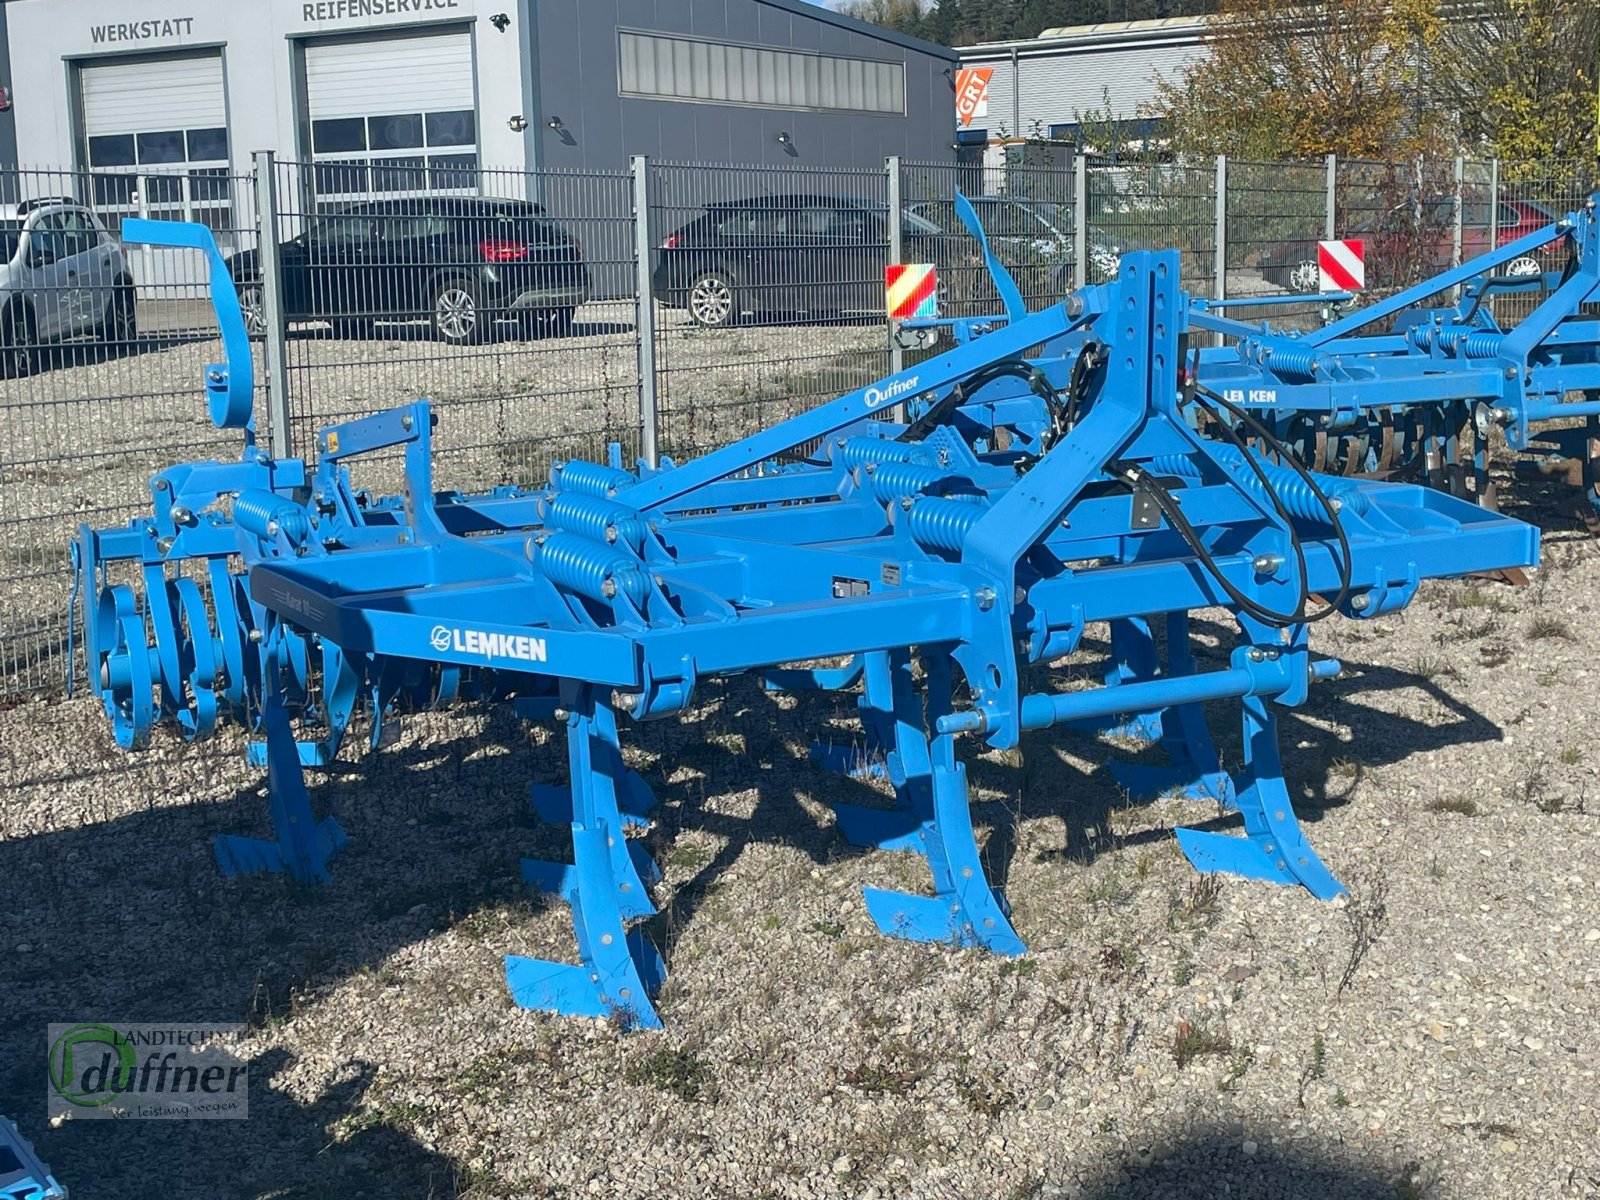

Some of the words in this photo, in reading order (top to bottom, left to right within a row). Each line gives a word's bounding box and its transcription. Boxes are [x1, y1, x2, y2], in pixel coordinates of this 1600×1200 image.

[91, 17, 193, 43] WERKSTATT
[959, 71, 986, 115] GRT
[453, 629, 547, 662] LEMKEN
